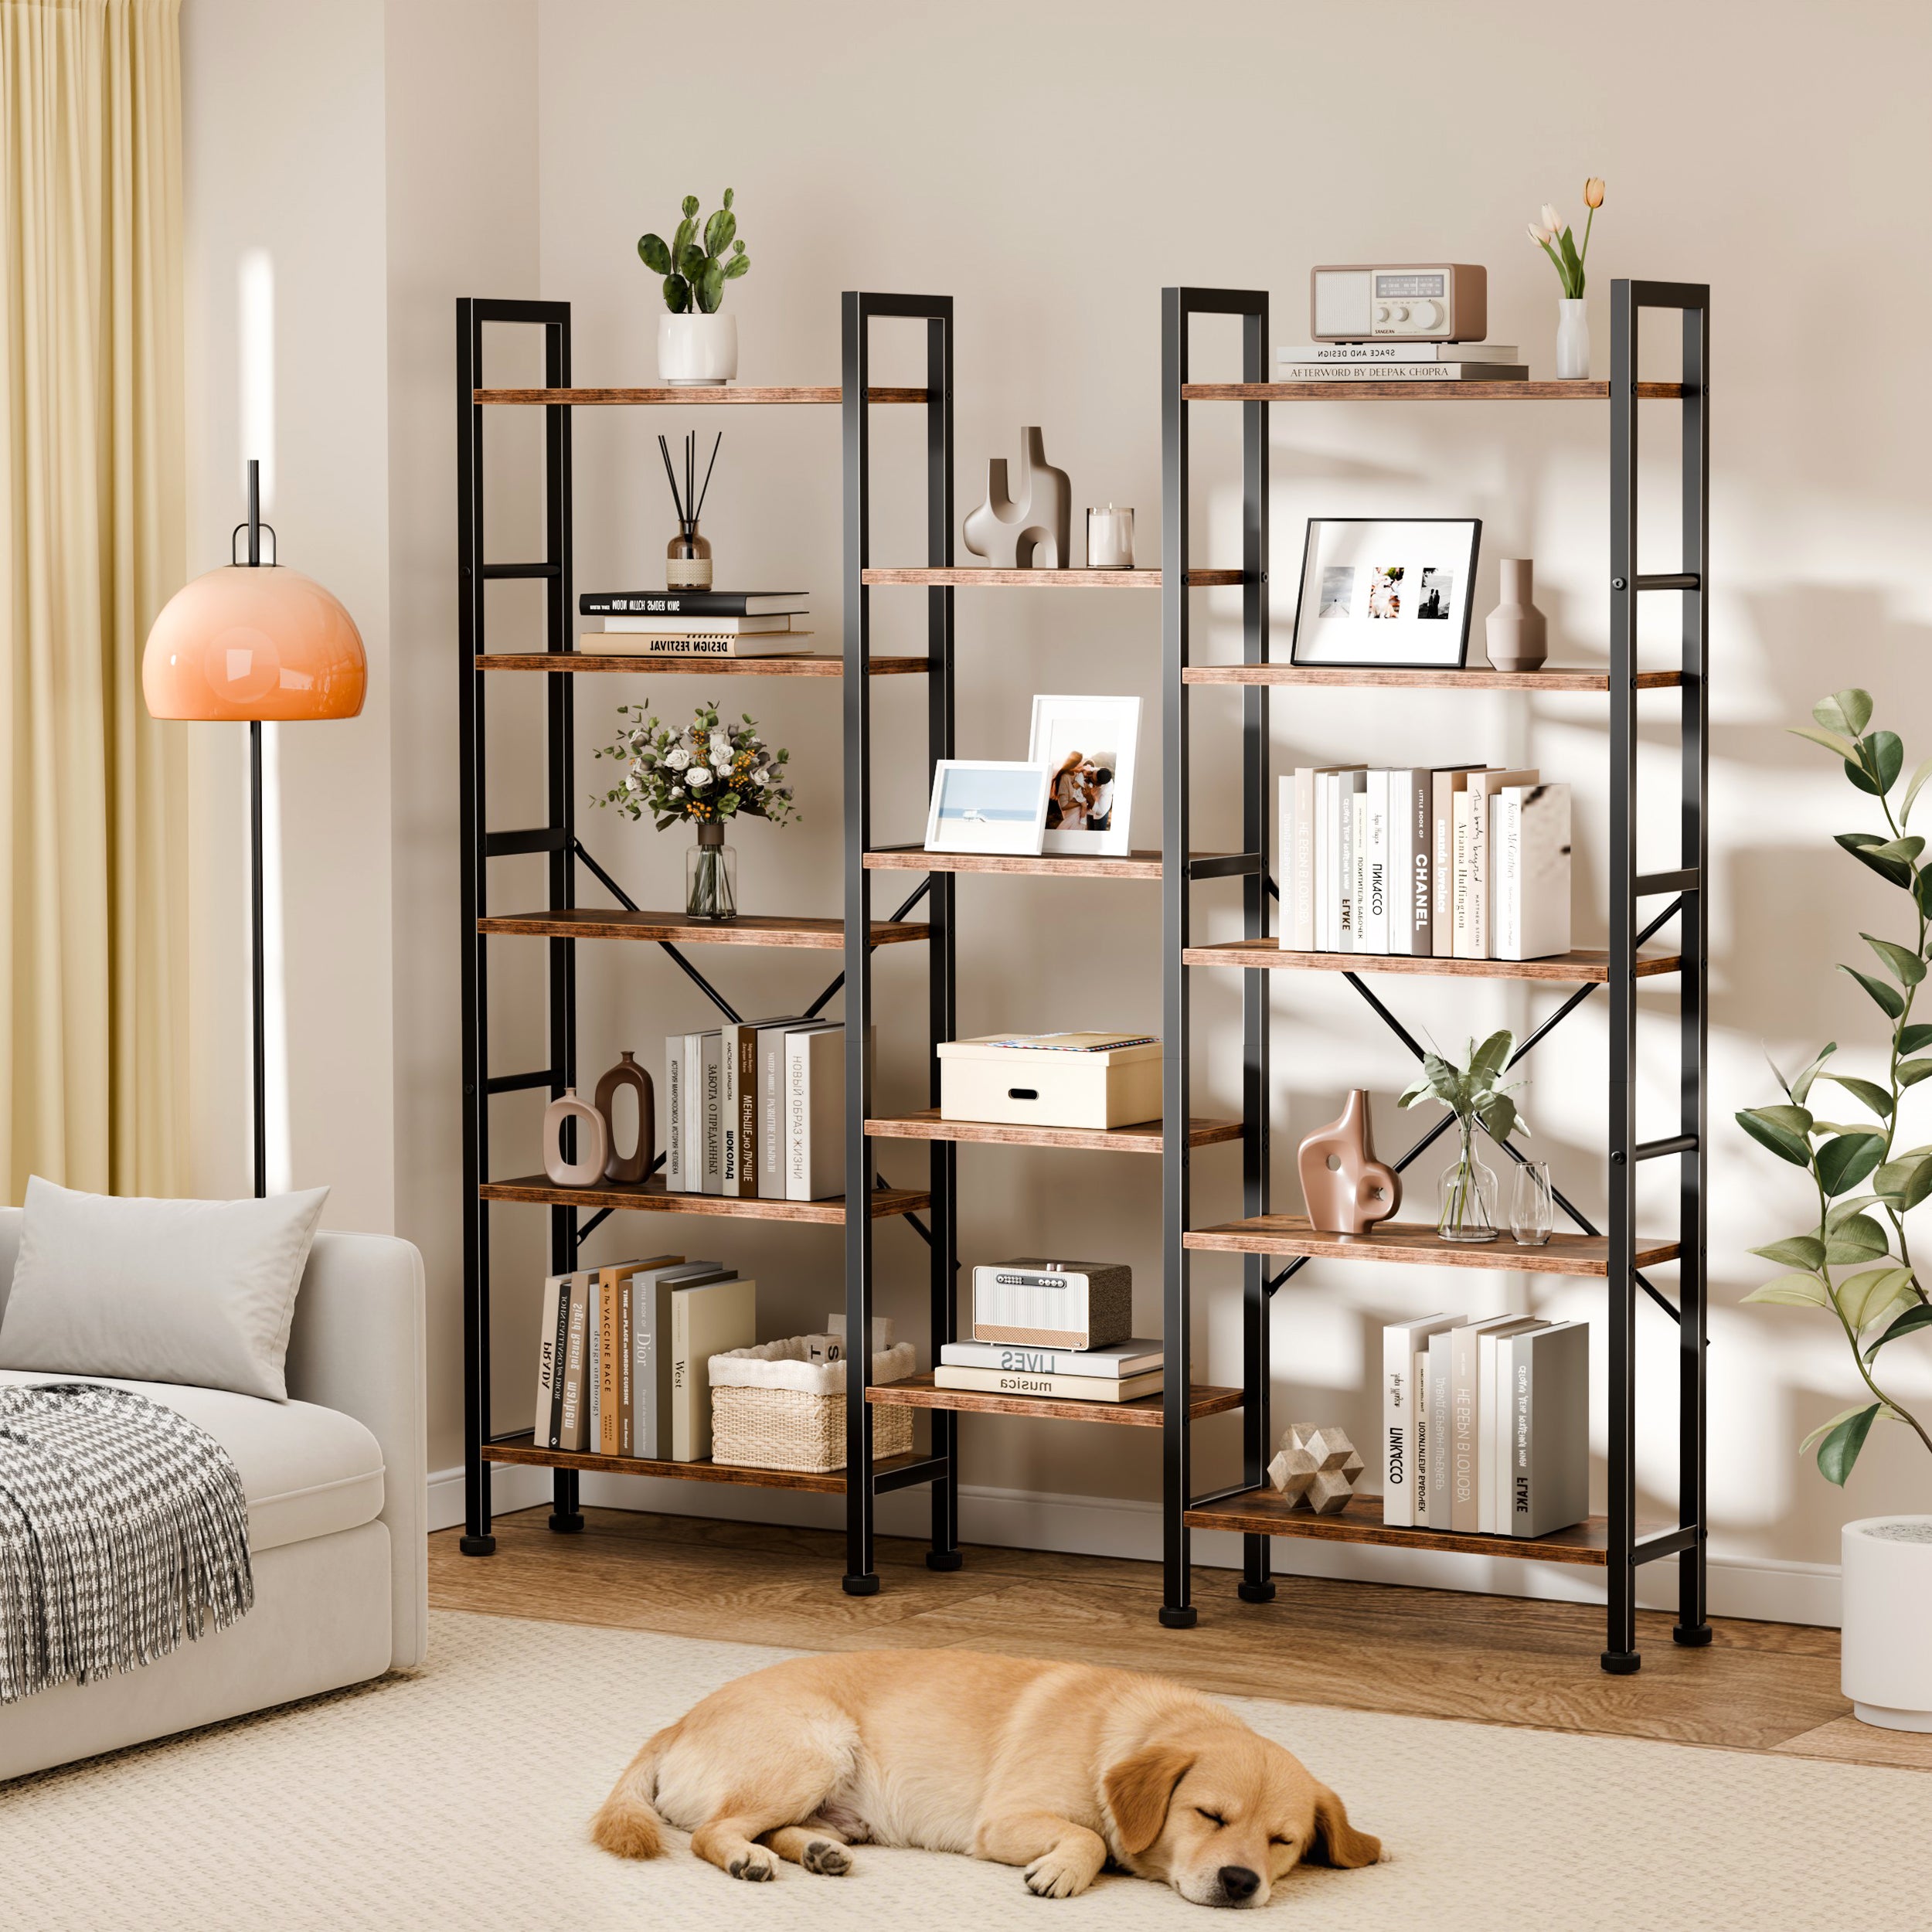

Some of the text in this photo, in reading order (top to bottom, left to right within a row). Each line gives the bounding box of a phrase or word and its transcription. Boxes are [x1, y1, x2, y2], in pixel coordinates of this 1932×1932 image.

[1291, 367, 1448, 378] AFTERWORD BY DEEPAK CHOPRA
[1419, 830, 1423, 838] OF
[1508, 802, 1517, 828] Karen
[1468, 789, 1483, 883] The body beyond
[1506, 832, 1517, 879] McCartney
[1437, 819, 1447, 913] amanda lovelace
[1456, 821, 1467, 928] Arianna Huffington
[1372, 863, 1383, 915] ПИКАССО
[1416, 854, 1428, 931] CHANEL
[708, 1064, 717, 1100] ЗАБОТА
[793, 1056, 804, 1179] НОВЫЙ ОБРАЗ ЖИЗНИ
[708, 1114, 718, 1175] ПРЕДАННЫХ
[726, 1131, 734, 1179] ШОКОЛАД
[743, 1150, 753, 1182] ЛУЧШЕ
[636, 1332, 651, 1366] Dior
[810, 1344, 821, 1359] T
[828, 1345, 838, 1360] S
[675, 1360, 685, 1389] West
